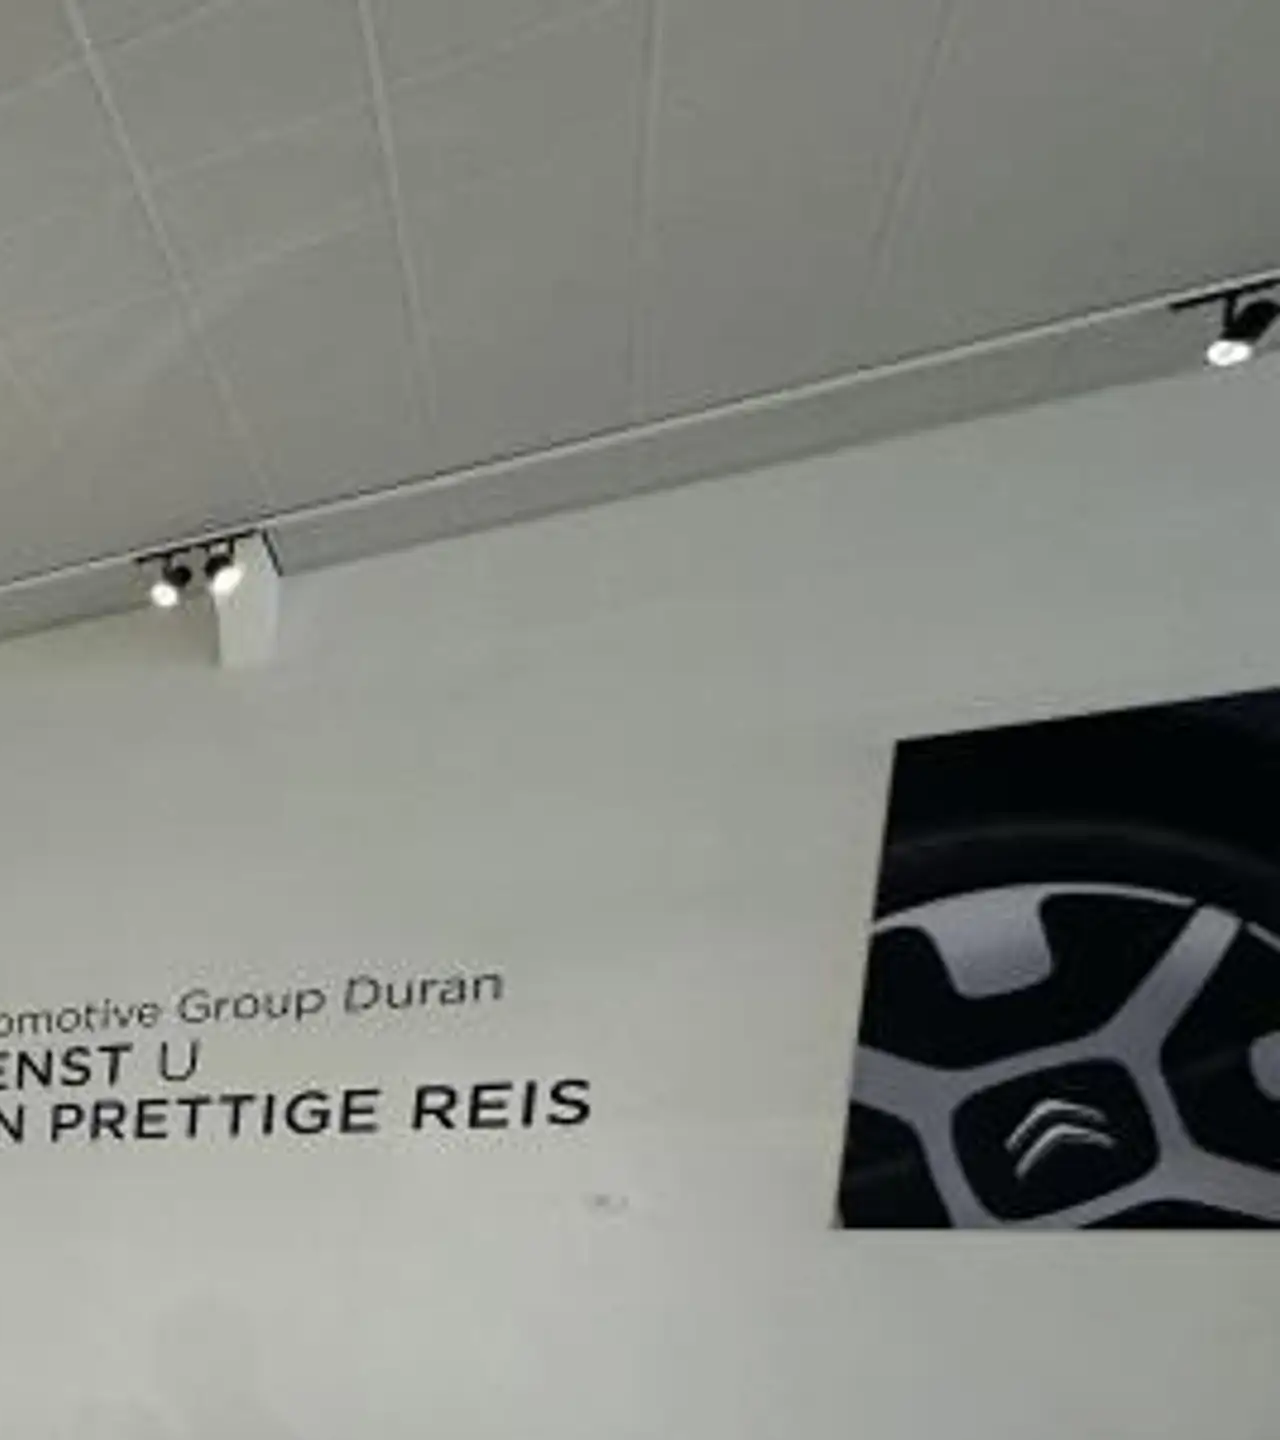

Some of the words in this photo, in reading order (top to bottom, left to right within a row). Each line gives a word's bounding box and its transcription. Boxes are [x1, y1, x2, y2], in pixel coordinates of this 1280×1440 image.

[178, 985, 326, 1025] Group
[344, 972, 504, 1015] Duran
[159, 1041, 200, 1082] U
[50, 1089, 382, 1142] PRETTIGE
[411, 1079, 592, 1131] REIS
